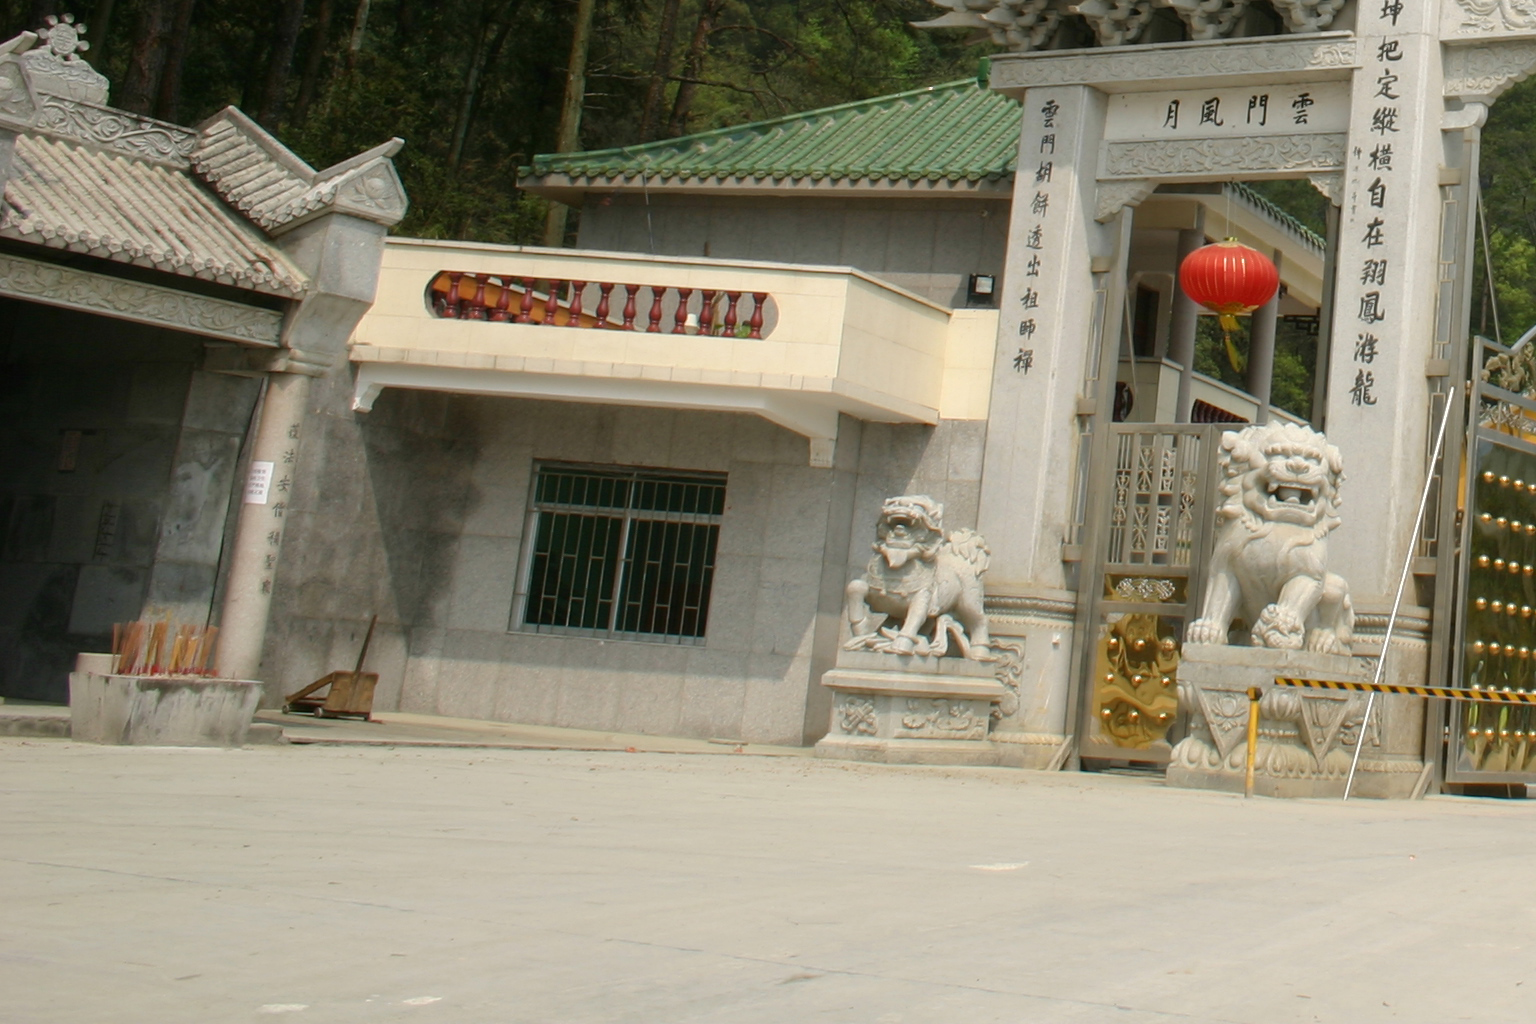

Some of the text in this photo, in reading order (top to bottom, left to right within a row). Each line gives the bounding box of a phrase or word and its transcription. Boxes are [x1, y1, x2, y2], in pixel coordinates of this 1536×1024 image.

[1163, 92, 1315, 130] 雲門風月
[1012, 99, 1060, 375] 雲門胡餅透出祖師禪
